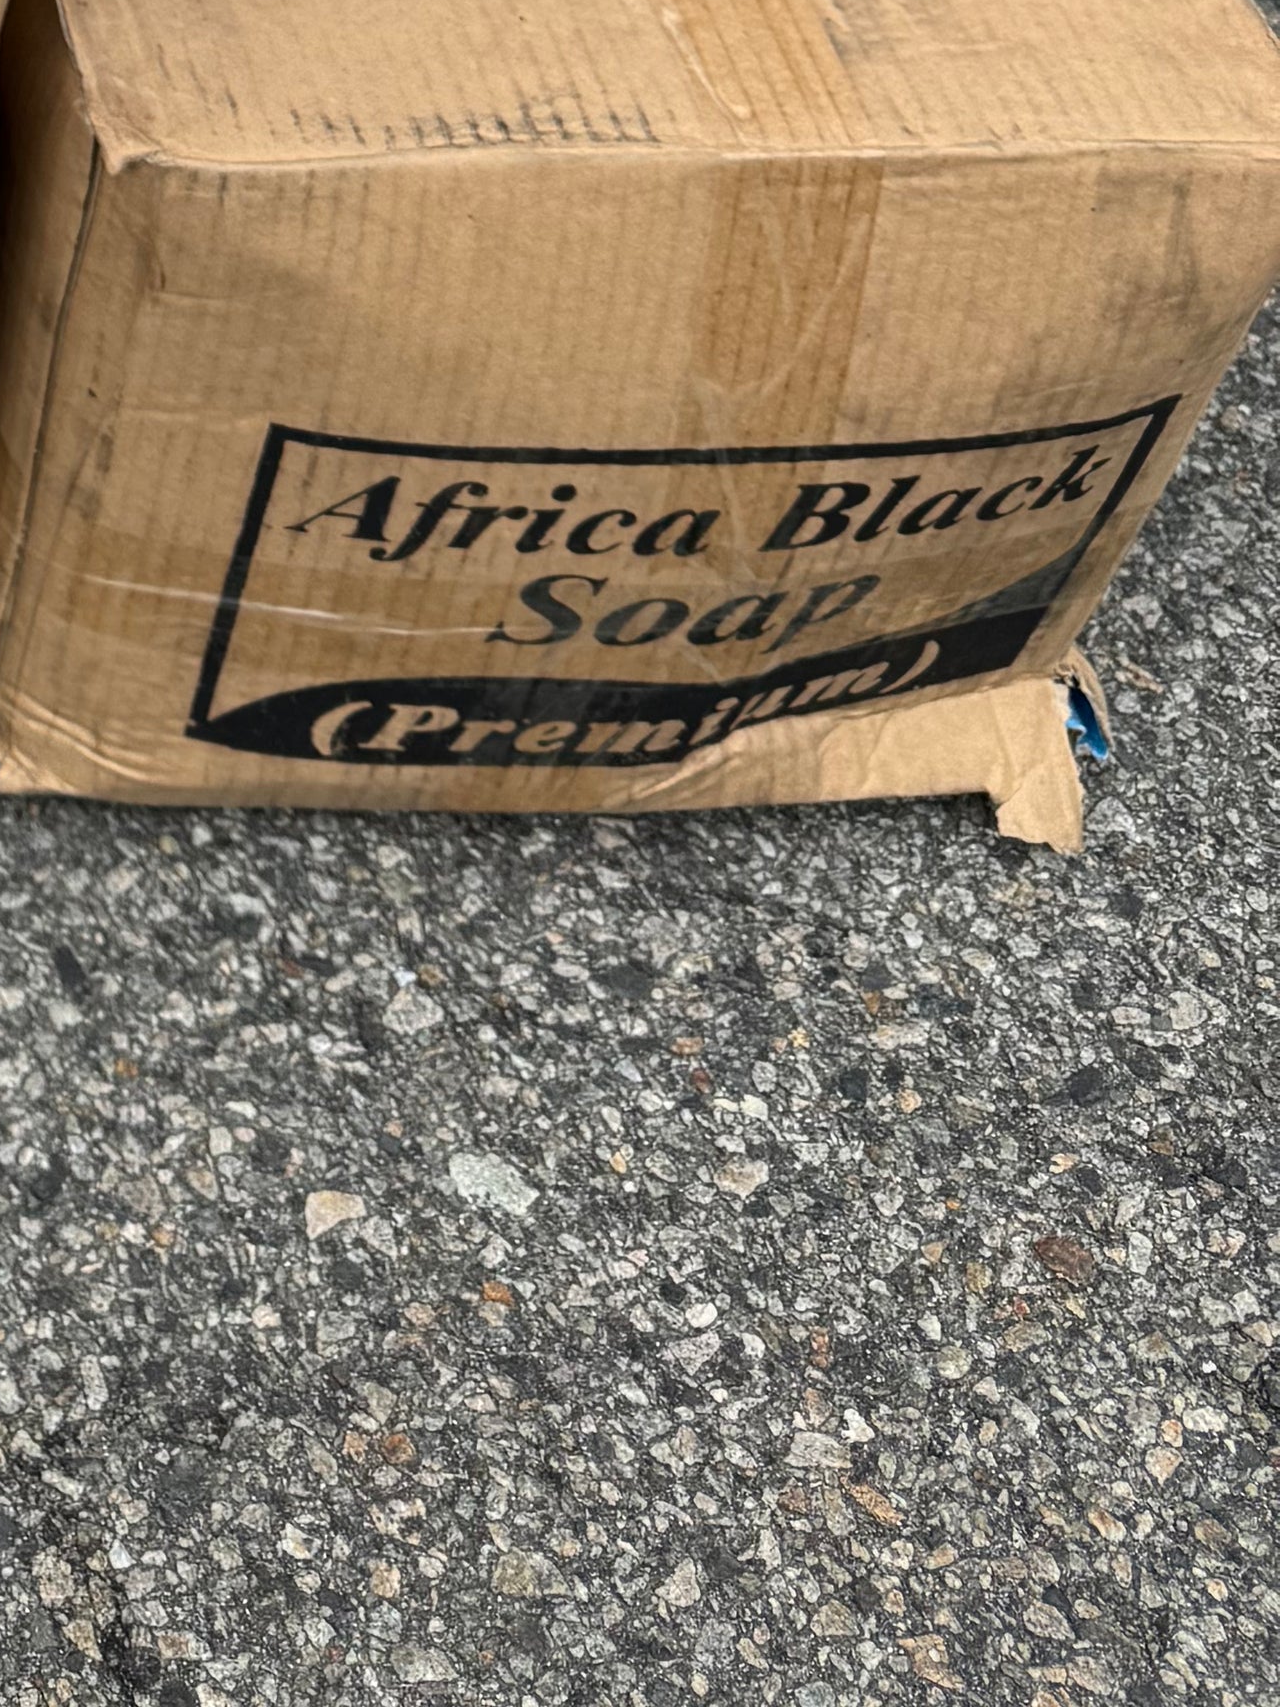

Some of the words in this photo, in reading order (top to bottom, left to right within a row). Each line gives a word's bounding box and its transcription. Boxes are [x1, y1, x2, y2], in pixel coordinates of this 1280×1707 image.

[287, 475, 714, 560] Africa
[758, 443, 1112, 555] Black
[484, 573, 883, 655] Soap
[308, 639, 941, 758] (Premium)
